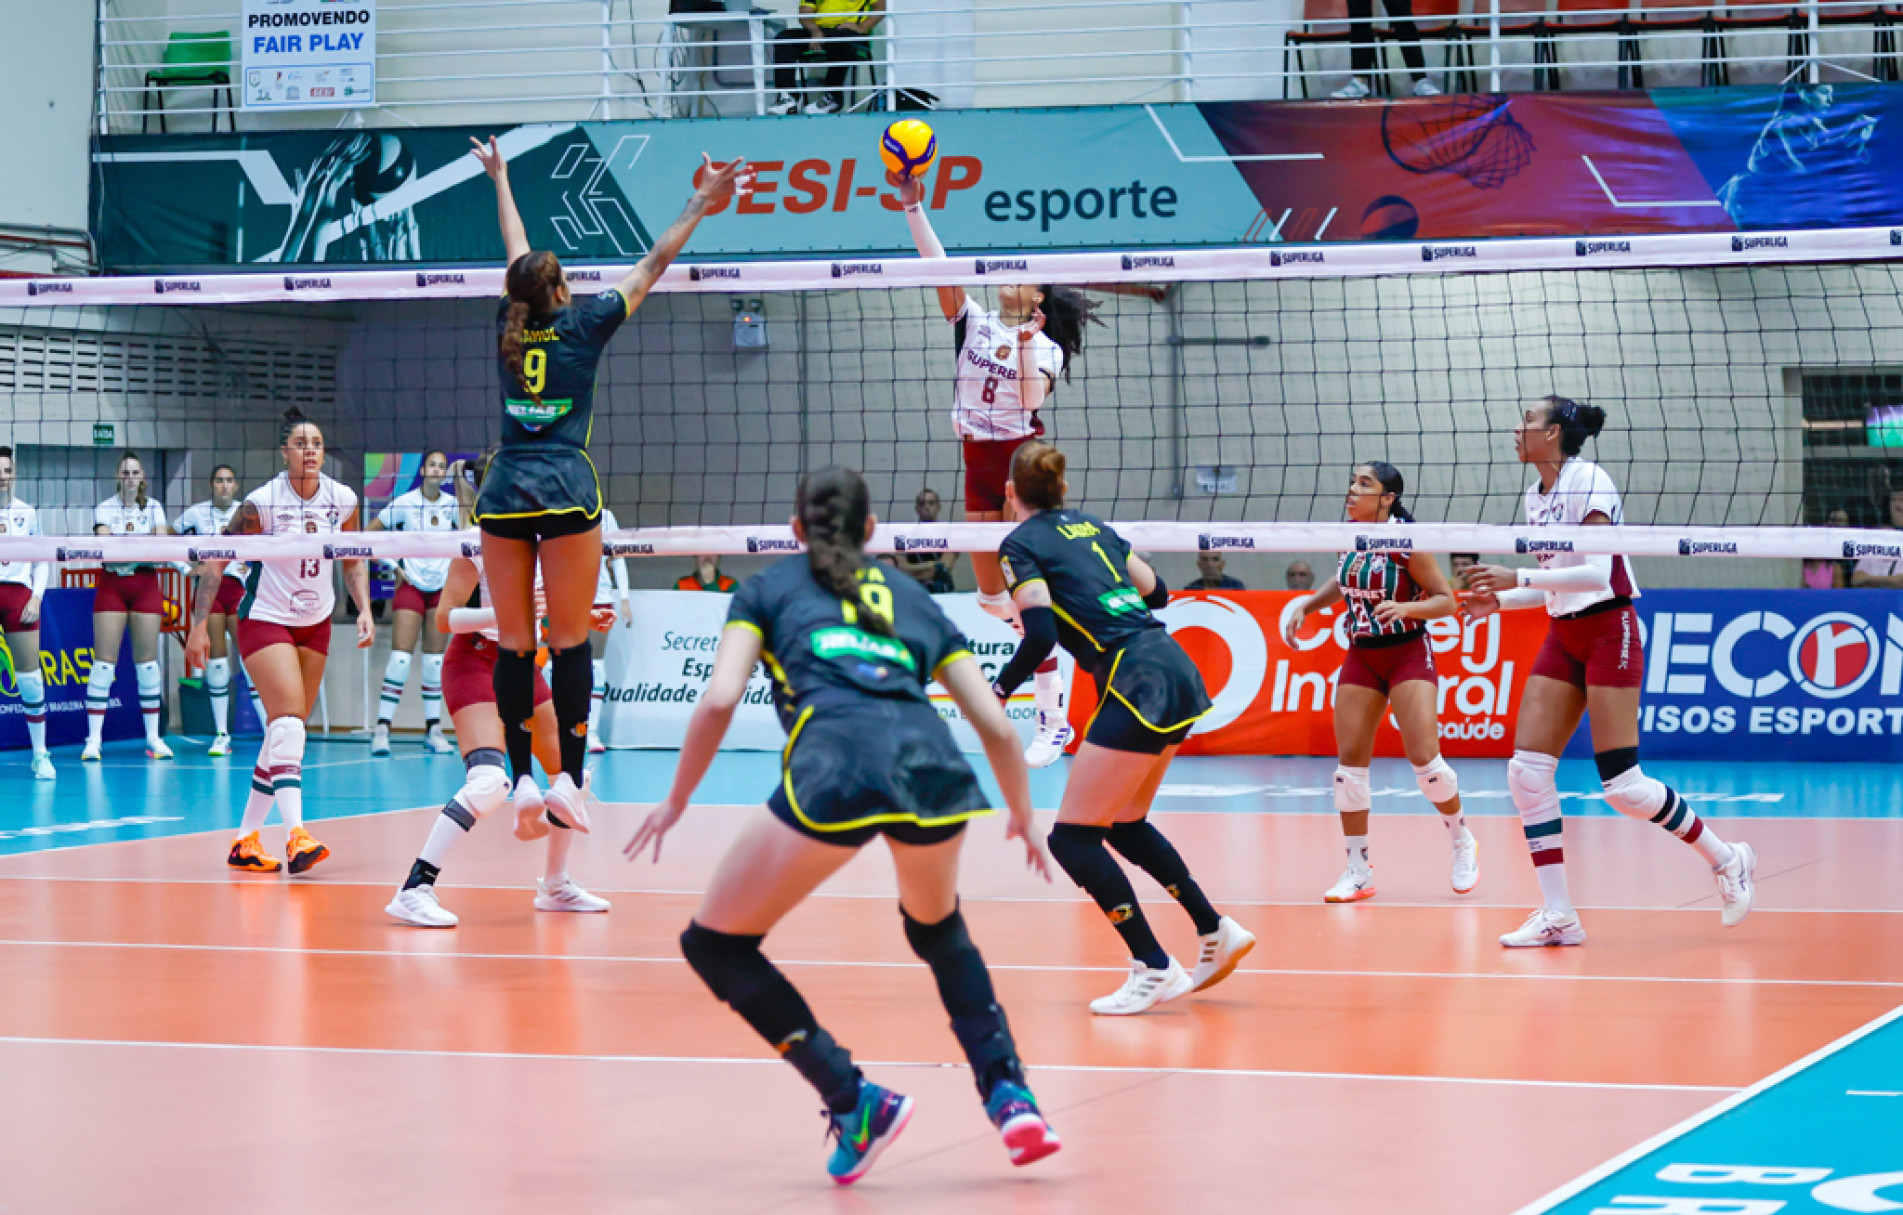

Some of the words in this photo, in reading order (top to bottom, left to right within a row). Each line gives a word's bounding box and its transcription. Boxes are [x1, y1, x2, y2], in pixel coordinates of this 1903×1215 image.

[248, 9, 370, 28] PROMOVENDO
[253, 34, 302, 54] FAIR
[309, 32, 364, 52] PLAY
[984, 180, 1178, 232] esporte
[1588, 241, 1631, 253] SUPERLIGA
[1744, 235, 1789, 249] SUPERLIGA
[1282, 251, 1325, 264] SUPERLIGA
[1434, 246, 1477, 259] SUPERLIGA
[986, 259, 1028, 271] SUPERLIGA
[1133, 256, 1176, 268] SUPERLIGA
[565, 270, 601, 281] UPERLIGA
[701, 267, 742, 280] SUPERLIGA
[842, 263, 883, 275] SUPERLIGA
[295, 278, 332, 289] SUPERLIGA
[427, 274, 465, 285] SUPERLIGA
[38, 282, 73, 293] SUPERLIGA
[165, 281, 201, 292] SUPERLIGA
[968, 349, 1017, 379] SUPERB
[524, 348, 547, 394] 9
[981, 377, 998, 404] 8
[613, 543, 654, 554] SUPERLIGA
[758, 539, 800, 551] SUPERLIGA
[906, 538, 948, 549] SUPERLIGA
[1211, 536, 1255, 549] SUPERLIGA
[1369, 537, 1413, 550] SUPERLIGA
[1529, 540, 1575, 552] SUPERLIGA
[1692, 541, 1738, 554] SUPERLIGA
[333, 547, 373, 558] SUPERLIGA
[1856, 543, 1901, 557] SUPERLIGA
[300, 559, 320, 578] 13
[1091, 541, 1123, 583] 1
[661, 631, 722, 651] Secret
[1638, 705, 1737, 733] ISOS
[1436, 717, 1504, 740] saúde
